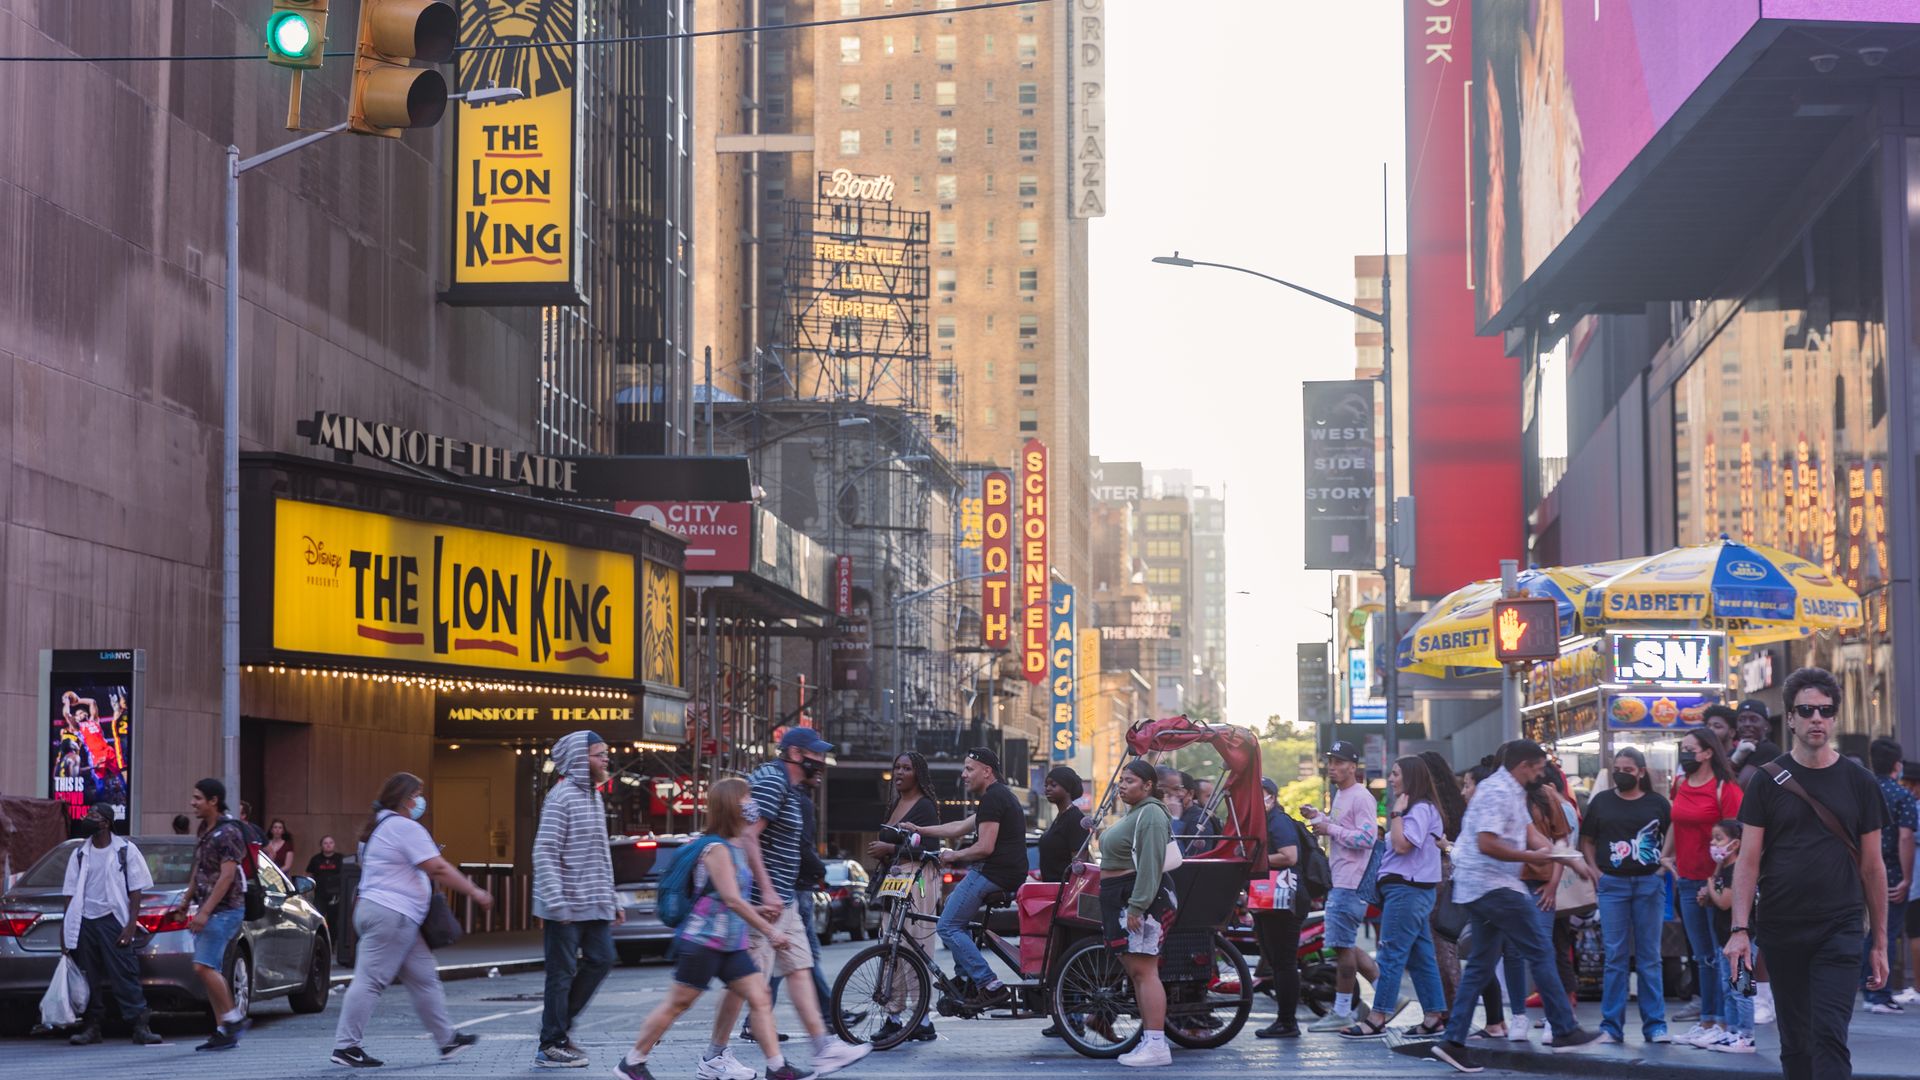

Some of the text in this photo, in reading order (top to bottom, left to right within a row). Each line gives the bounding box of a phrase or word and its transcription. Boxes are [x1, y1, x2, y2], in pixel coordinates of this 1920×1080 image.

[1425, 0, 1453, 64] RK
[482, 124, 539, 151] THE
[1078, 82, 1103, 214] PLAZA
[472, 159, 550, 206] LION
[826, 168, 896, 201] Booth
[465, 211, 561, 267] KING
[815, 244, 903, 265] FREESTYLE
[841, 272, 884, 290] LOVE
[822, 300, 898, 320] SUPREME
[1311, 427, 1369, 440] WEST
[315, 411, 578, 493] MINSKOFF THEATRE
[1314, 457, 1366, 470] SIDE
[1306, 487, 1375, 500] STORY
[668, 505, 720, 522] CITY
[668, 525, 738, 535] PARKING
[985, 478, 1008, 641] BOOTH
[1025, 451, 1045, 673] SCHOENFELD
[306, 575, 340, 588] PRESENTS
[349, 535, 611, 664] THE LION KING
[1610, 593, 1705, 611] SABRETT
[1803, 598, 1860, 618] SABRETT
[1101, 627, 1125, 640] THE
[1418, 628, 1490, 652] SABRETT
[100, 652, 131, 660] LinkNYC
[1053, 594, 1072, 751] JACOBS
[449, 708, 634, 720] MINSKOFF THEATRE
[54, 776, 84, 792] THIS IS
